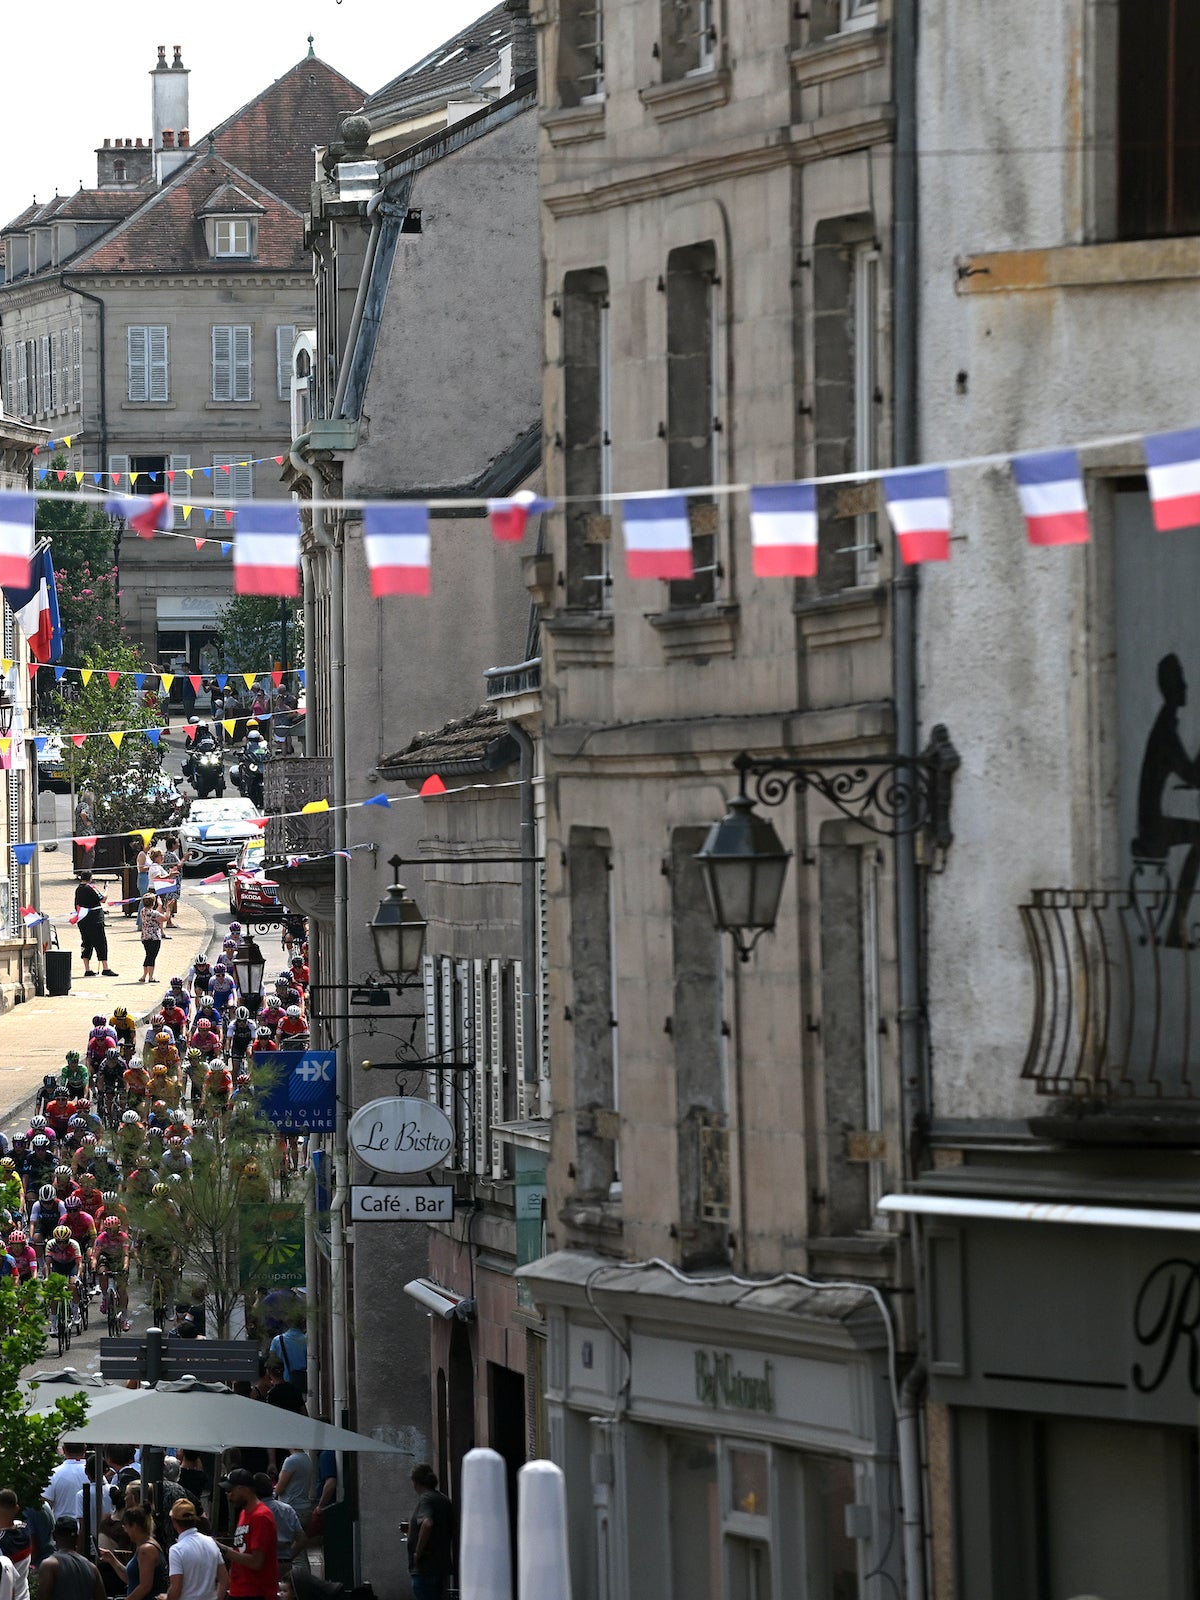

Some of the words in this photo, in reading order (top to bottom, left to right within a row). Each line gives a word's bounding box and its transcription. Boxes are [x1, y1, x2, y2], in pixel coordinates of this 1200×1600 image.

[260, 1108, 333, 1118] BANQUE
[356, 1121, 389, 1151] Le
[394, 1121, 451, 1151] Bistro
[360, 1195, 401, 1212] Café
[415, 1196, 445, 1212] Bar
